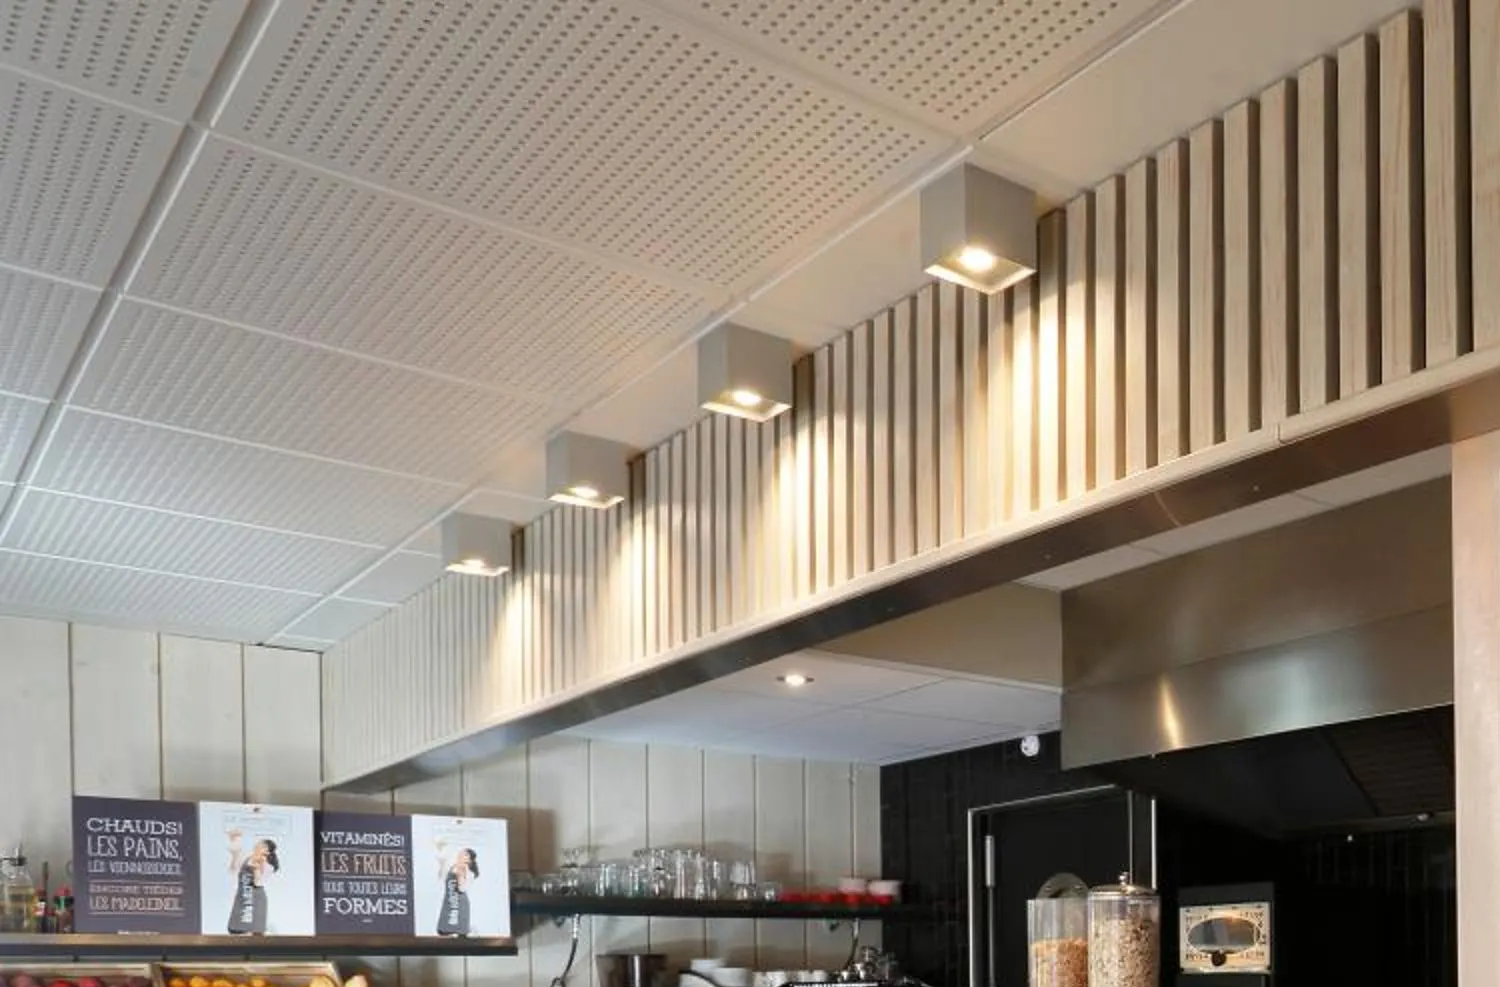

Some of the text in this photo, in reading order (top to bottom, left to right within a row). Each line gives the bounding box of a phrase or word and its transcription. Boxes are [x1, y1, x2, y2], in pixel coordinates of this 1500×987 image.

[86, 817, 183, 835] CHAUDS!
[87, 835, 118, 857] LES
[321, 851, 408, 875] LES FRUITS
[323, 897, 408, 915] FORMES
